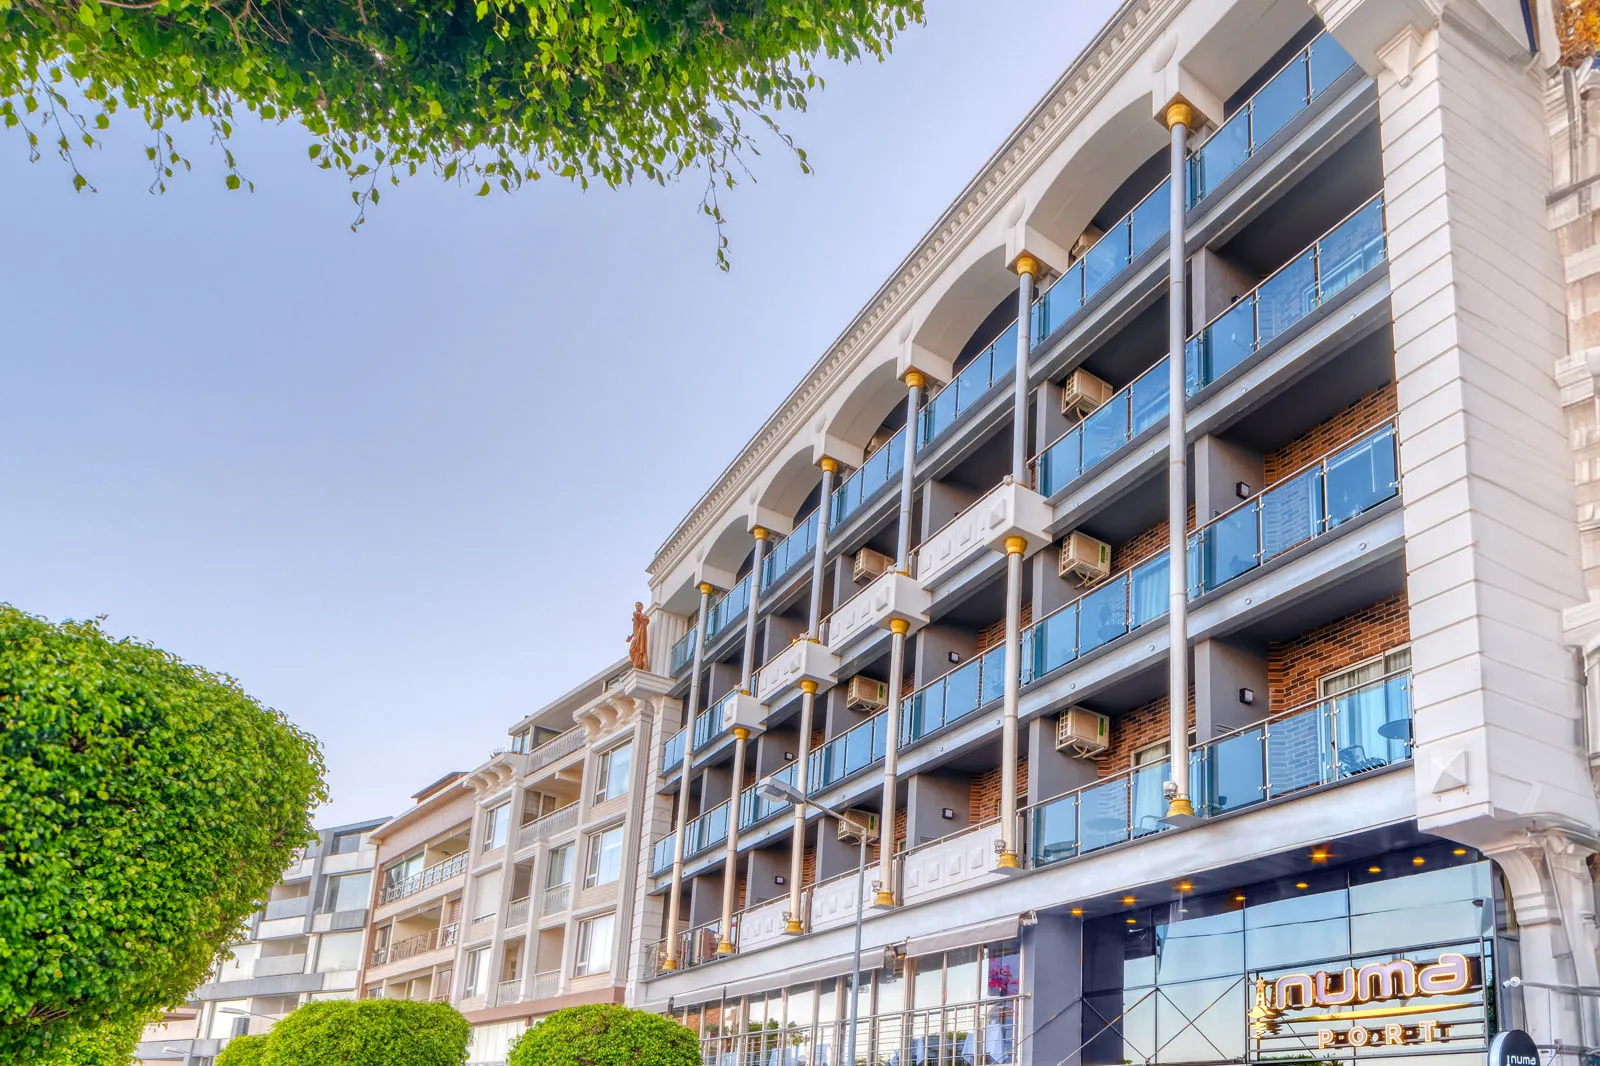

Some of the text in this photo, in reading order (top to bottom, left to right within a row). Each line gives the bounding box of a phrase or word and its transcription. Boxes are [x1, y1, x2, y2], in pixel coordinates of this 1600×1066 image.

[1275, 953, 1469, 1010] numa
[1318, 1020, 1438, 1050] PORT
[1510, 1054, 1537, 1065] numa
